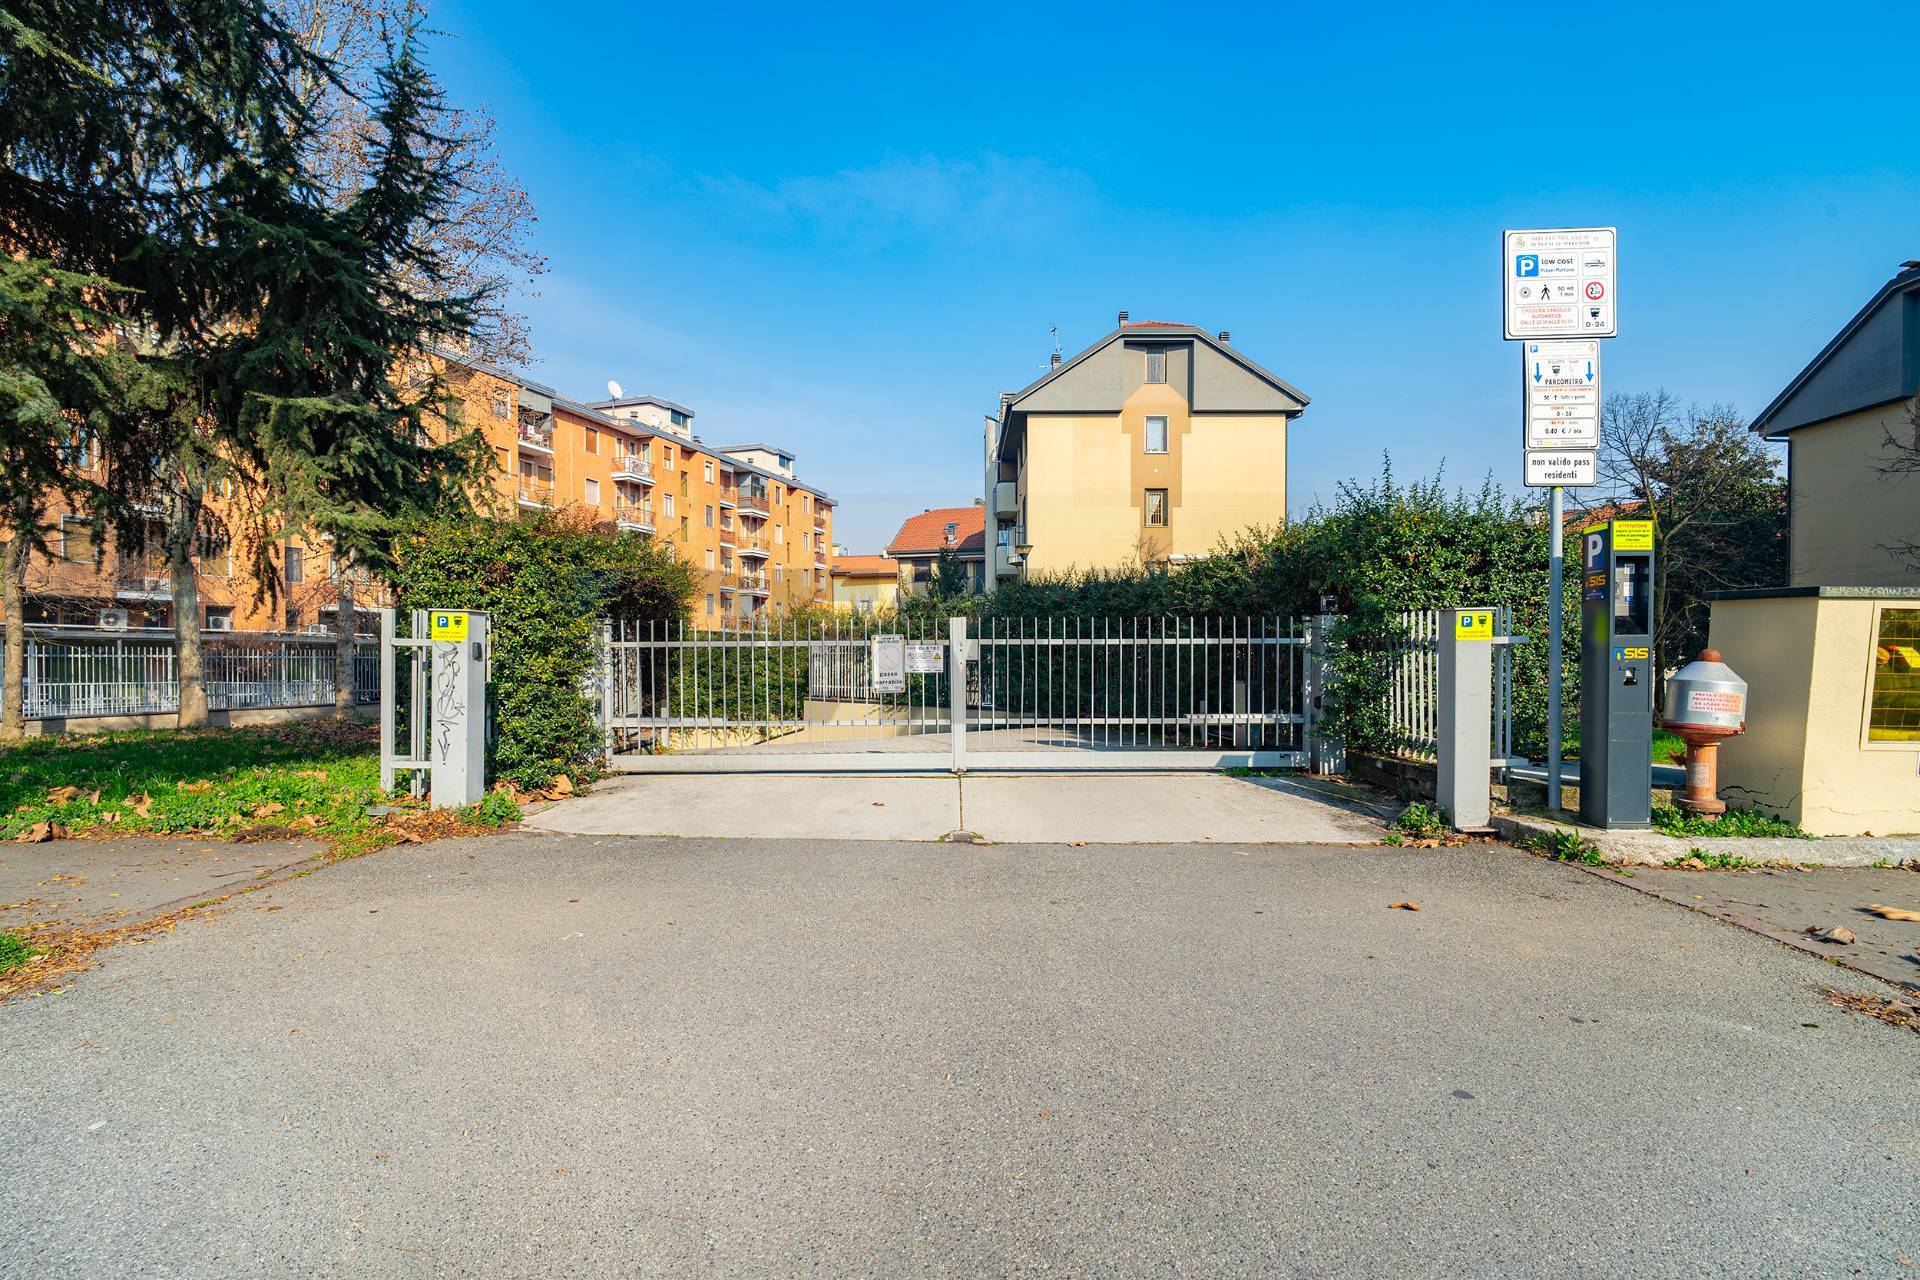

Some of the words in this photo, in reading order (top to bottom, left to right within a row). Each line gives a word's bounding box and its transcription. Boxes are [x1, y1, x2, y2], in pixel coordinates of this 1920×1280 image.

[1520, 260, 1534, 276] P
[1548, 457, 1570, 466] valido
[1574, 459, 1590, 467] pass
[1544, 471, 1577, 479] residenti
[1588, 534, 1603, 568] P
[440, 618, 446, 626] P
[1464, 617, 1471, 626] P
